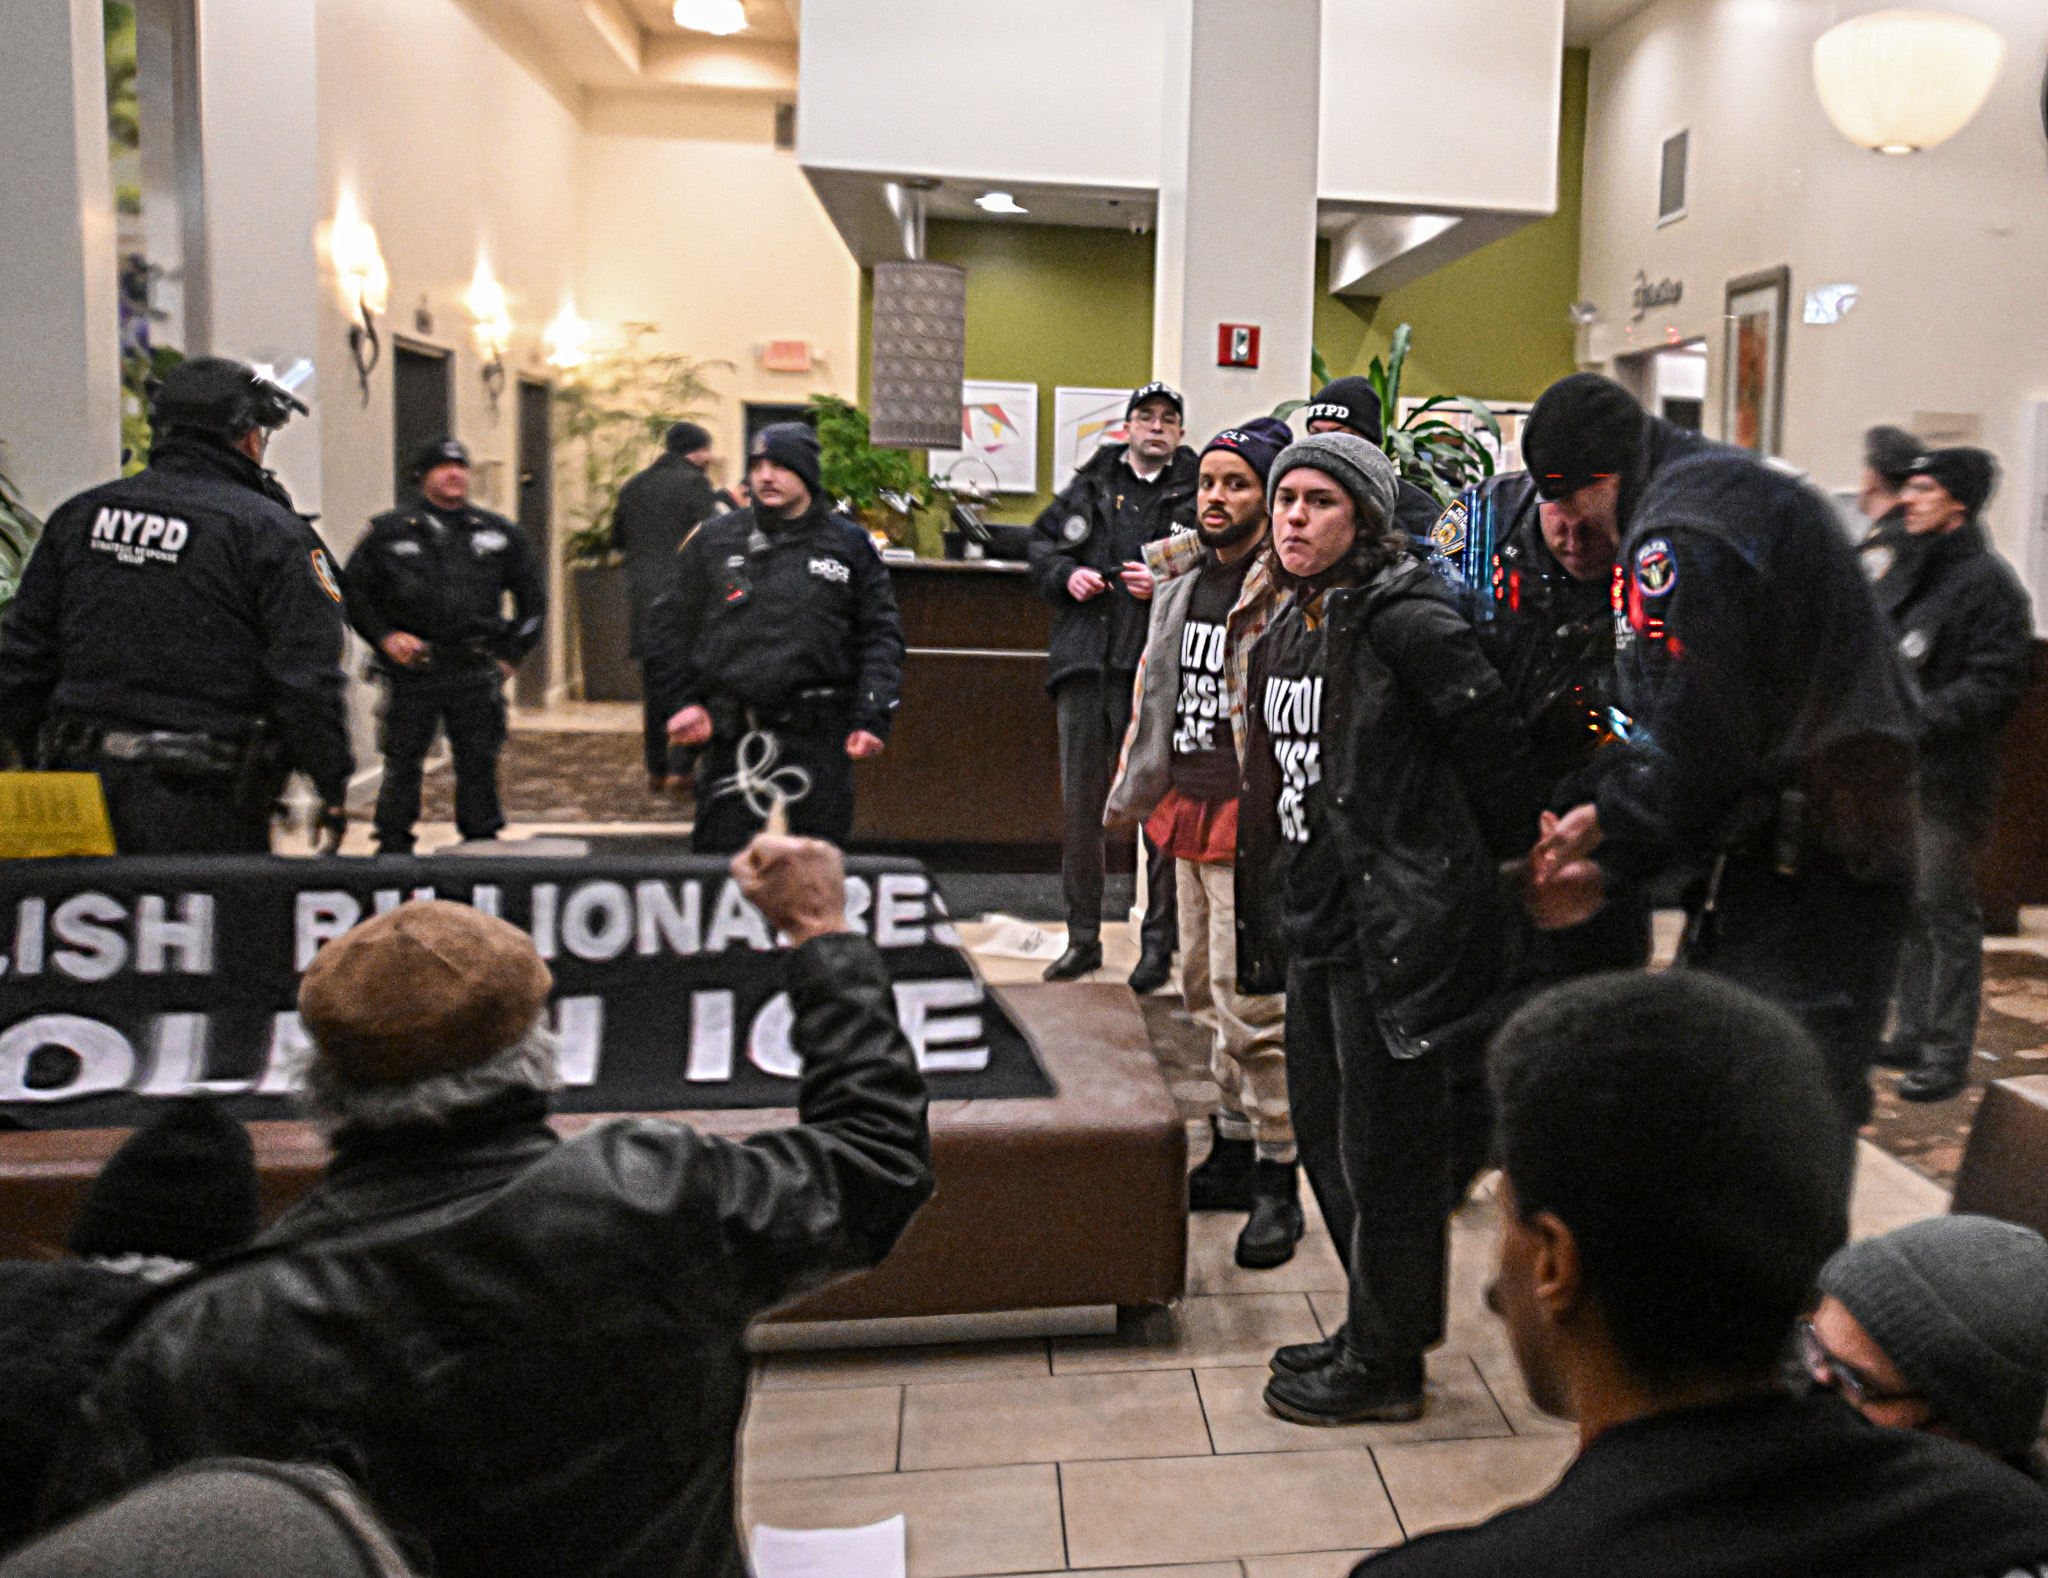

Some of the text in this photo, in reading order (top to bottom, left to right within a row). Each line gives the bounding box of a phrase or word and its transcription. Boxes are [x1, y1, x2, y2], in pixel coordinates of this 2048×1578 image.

[91, 506, 188, 552] NYPD
[0, 871, 964, 982] ISH BIONARE
